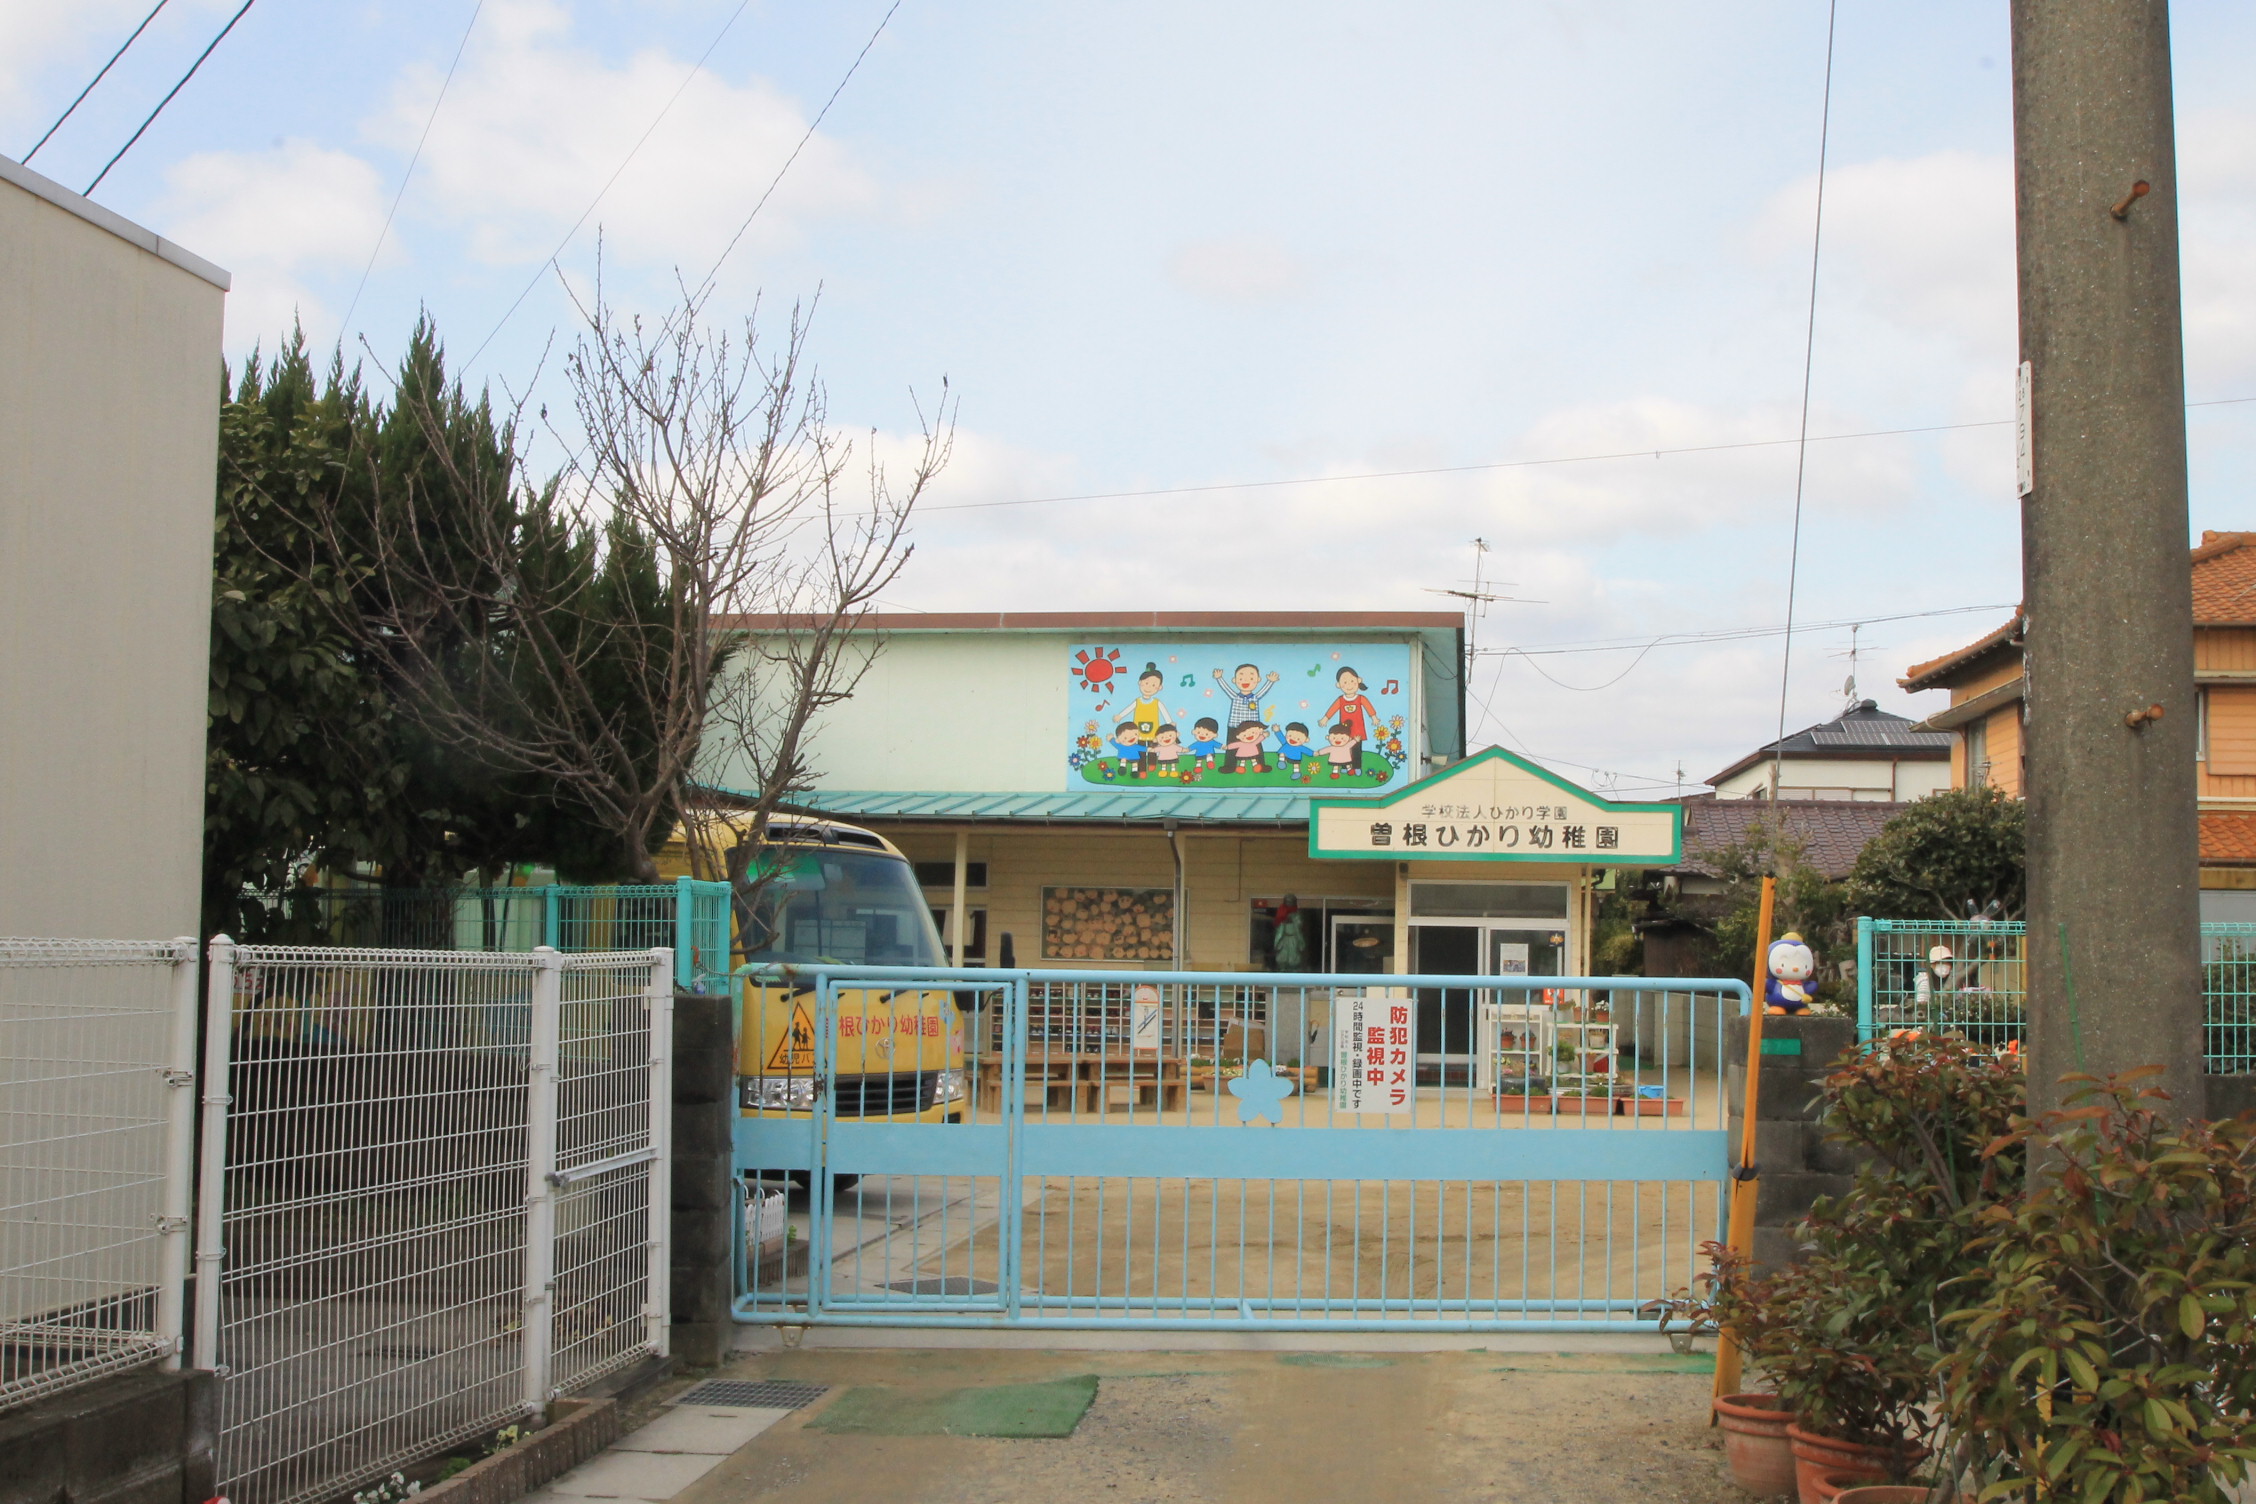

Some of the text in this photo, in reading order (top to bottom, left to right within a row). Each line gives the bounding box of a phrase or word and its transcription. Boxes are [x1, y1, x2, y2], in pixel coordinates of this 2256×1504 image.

[1422, 805, 1568, 820] 学校法人ひかり学園
[1371, 823, 1618, 848] 曽根ひかり幼稚園
[826, 1015, 938, 1037] 根ひかり幼稚園
[779, 1053, 817, 1065] 幼児バ
[1352, 1001, 1363, 1109] 24時間監視・録画中です
[1367, 1027, 1384, 1086] 監視中
[1390, 1006, 1408, 1105] 防犯カメラ
